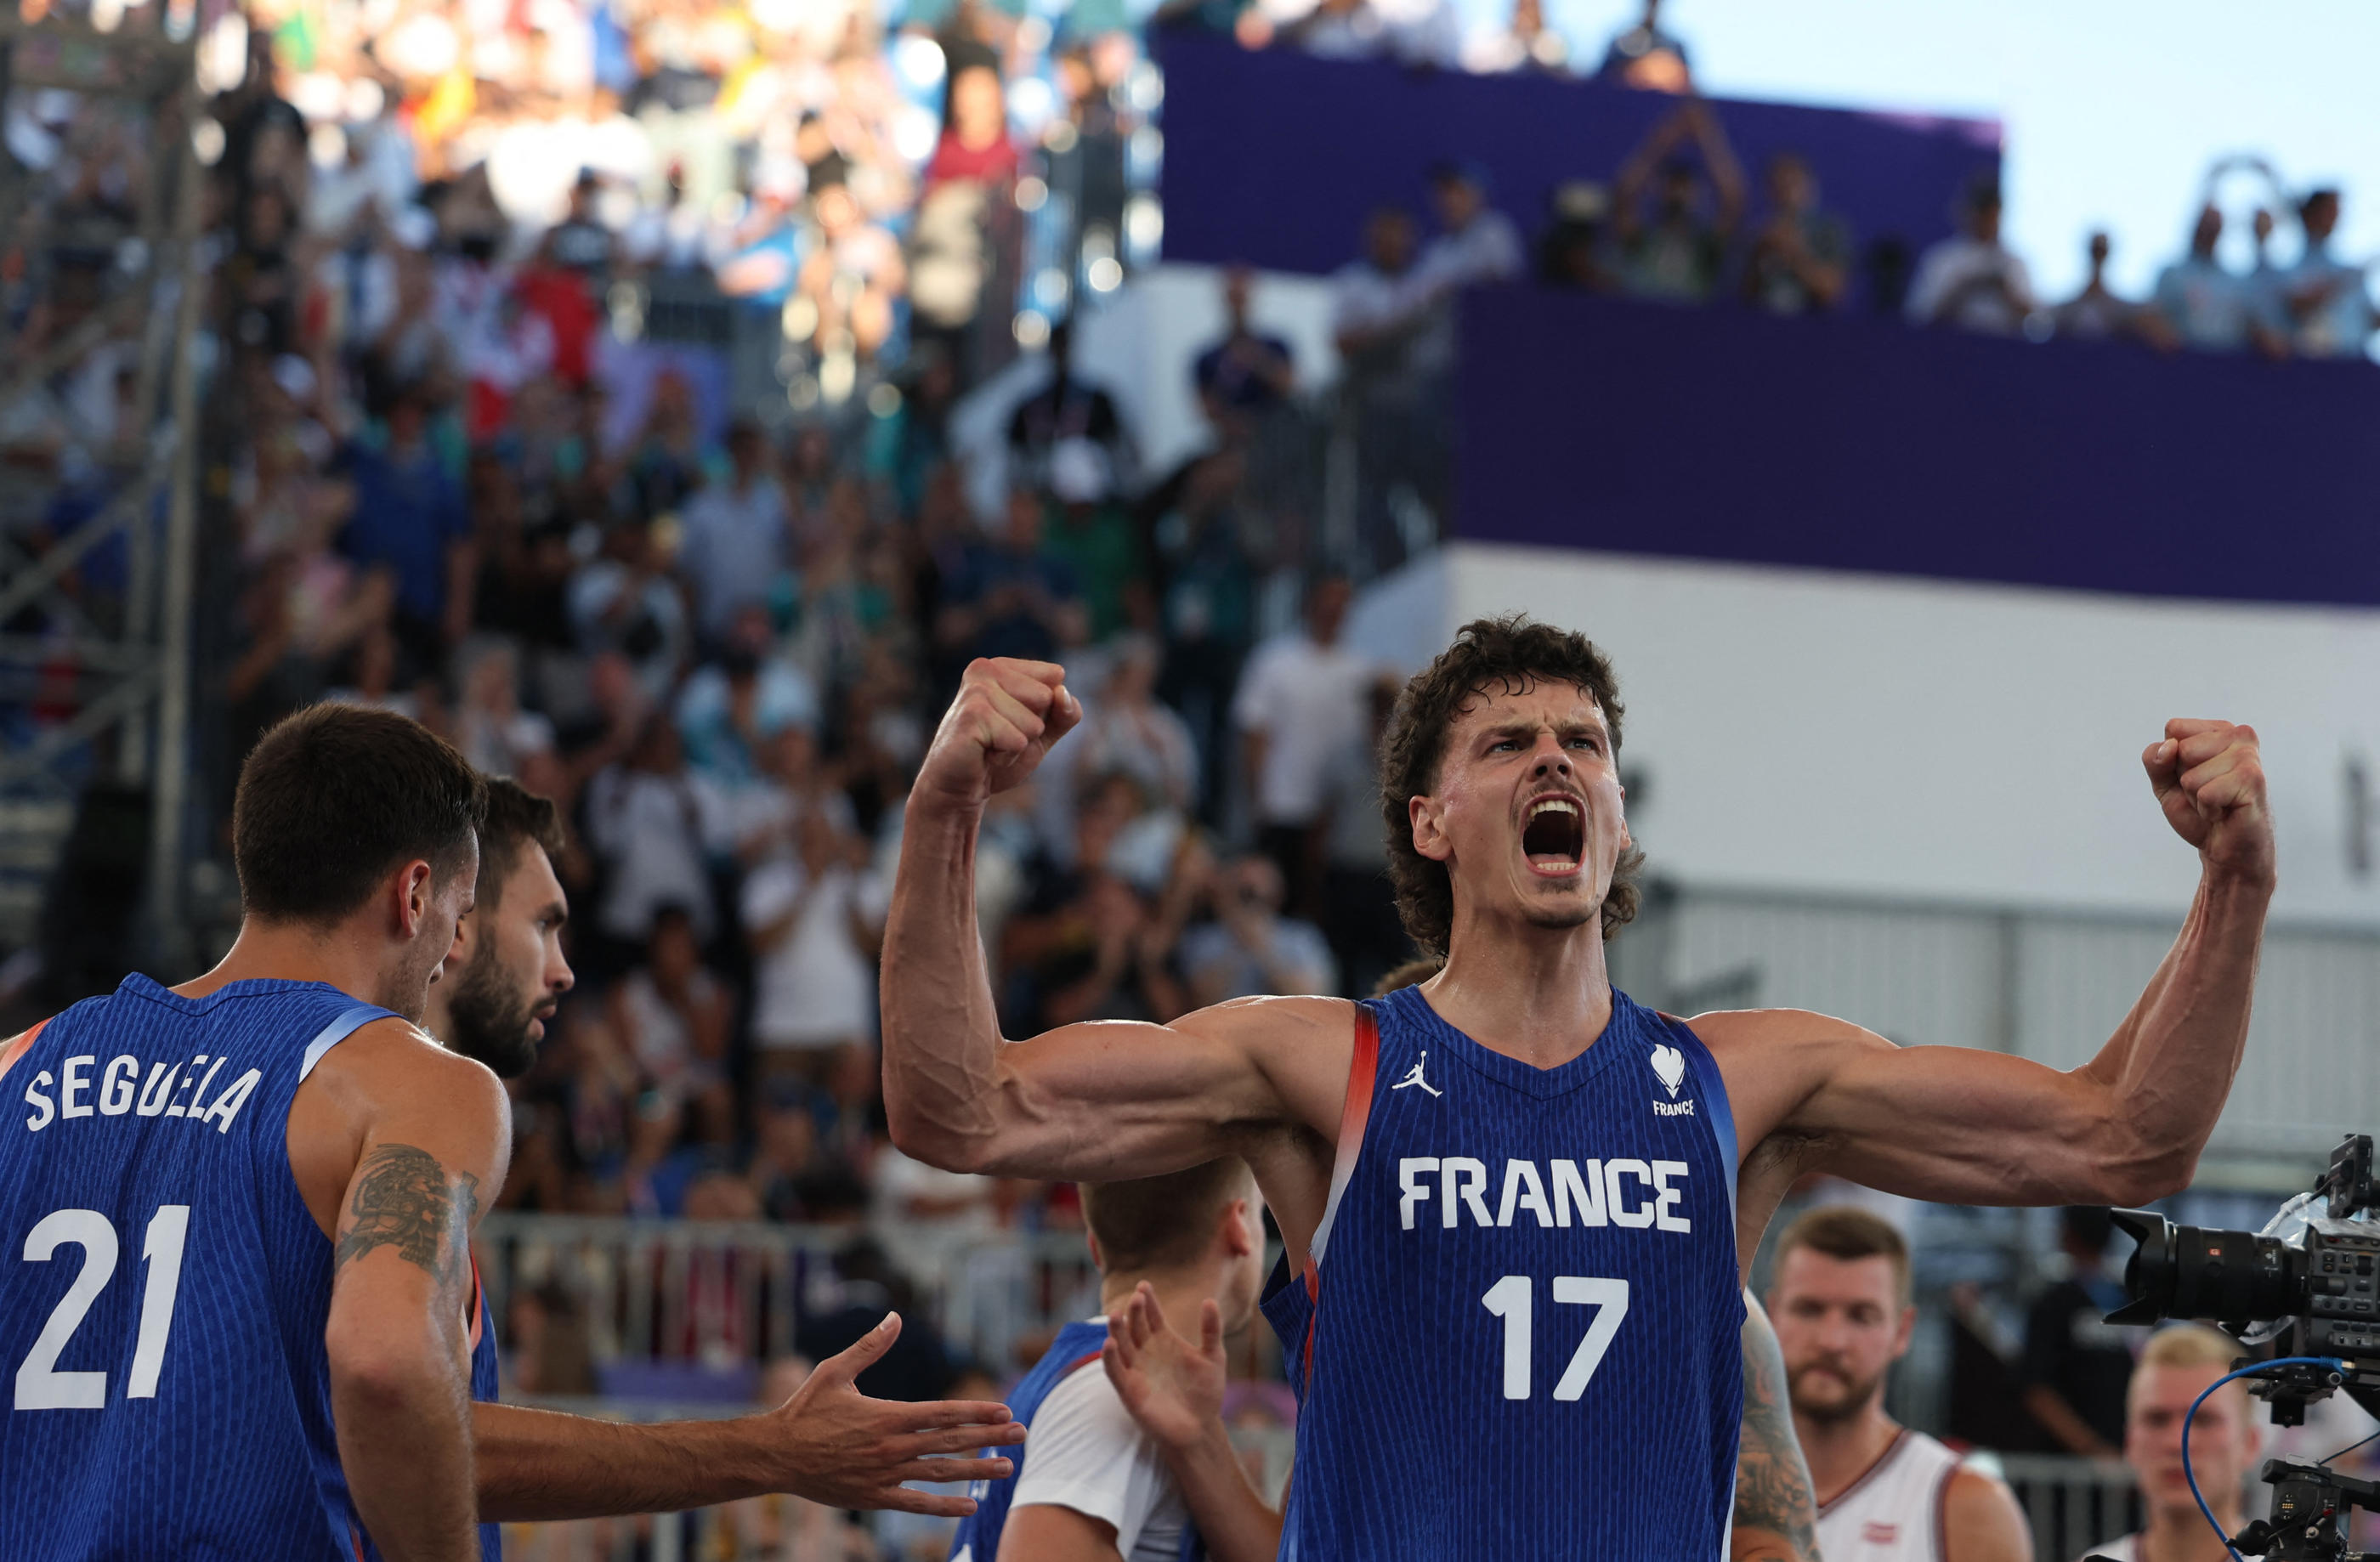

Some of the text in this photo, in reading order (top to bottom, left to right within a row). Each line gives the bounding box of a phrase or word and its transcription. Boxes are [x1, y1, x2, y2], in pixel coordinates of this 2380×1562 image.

[25, 1054, 262, 1135] SEGUELA
[1652, 1099, 1695, 1117] FRANCE
[1399, 1157, 1691, 1233] FRANCE
[14, 1204, 190, 1411] 21
[1482, 1276, 1629, 1401] 17
